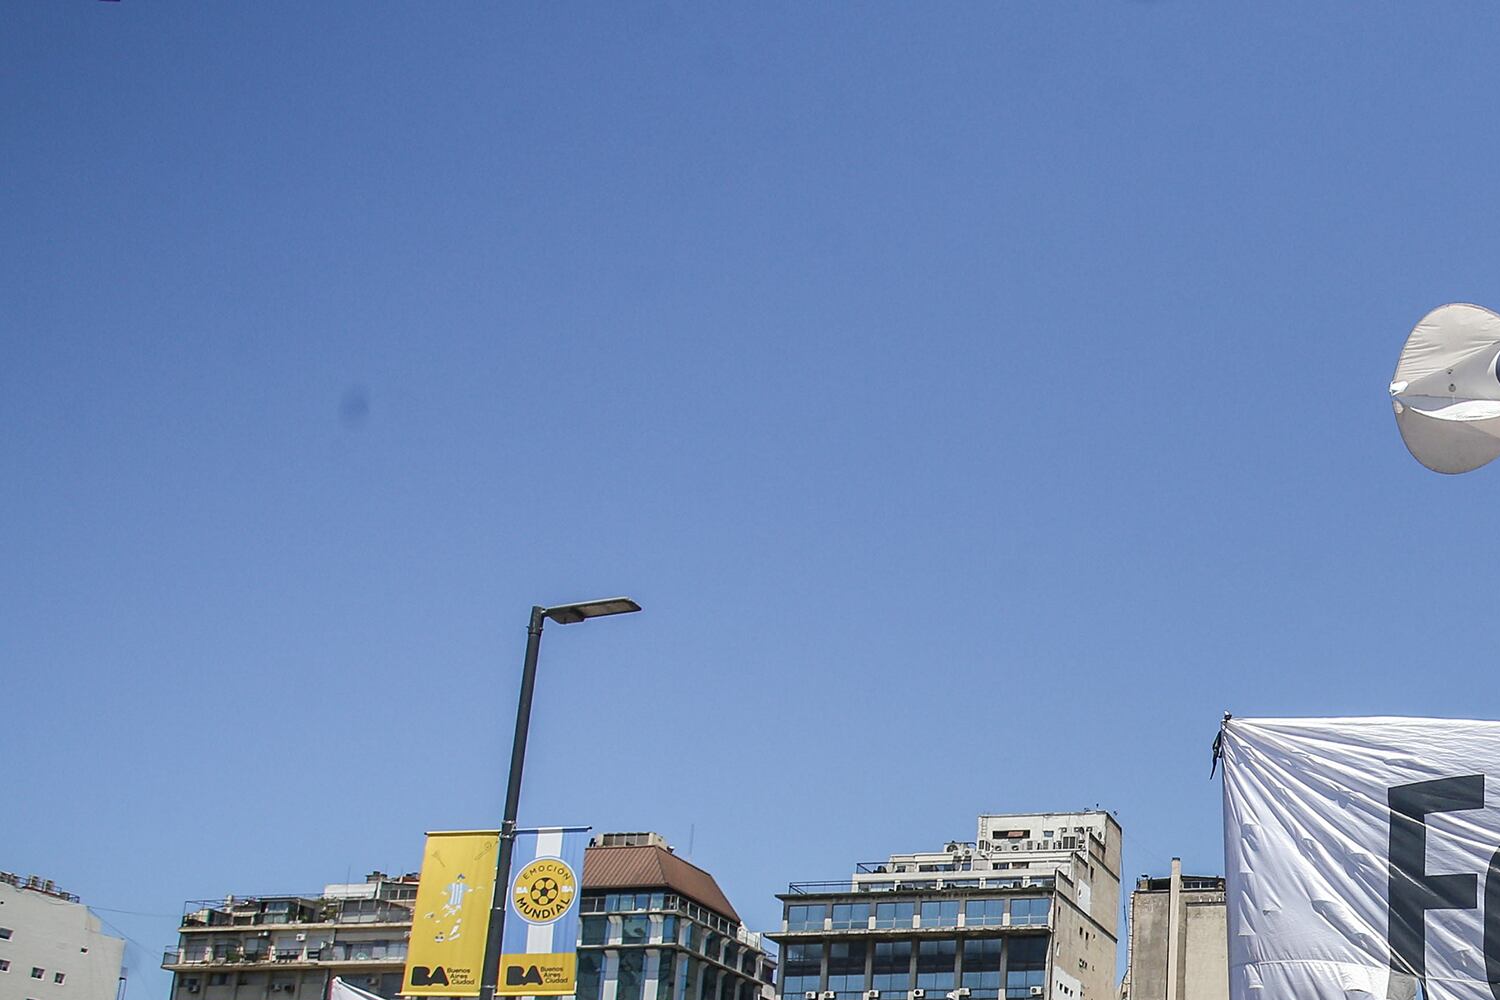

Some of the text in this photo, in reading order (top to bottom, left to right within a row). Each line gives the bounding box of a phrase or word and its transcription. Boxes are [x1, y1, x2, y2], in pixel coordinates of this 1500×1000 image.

[517, 897, 570, 919] MUNDIAL
[411, 966, 449, 986] BA
[506, 965, 543, 986] BA
